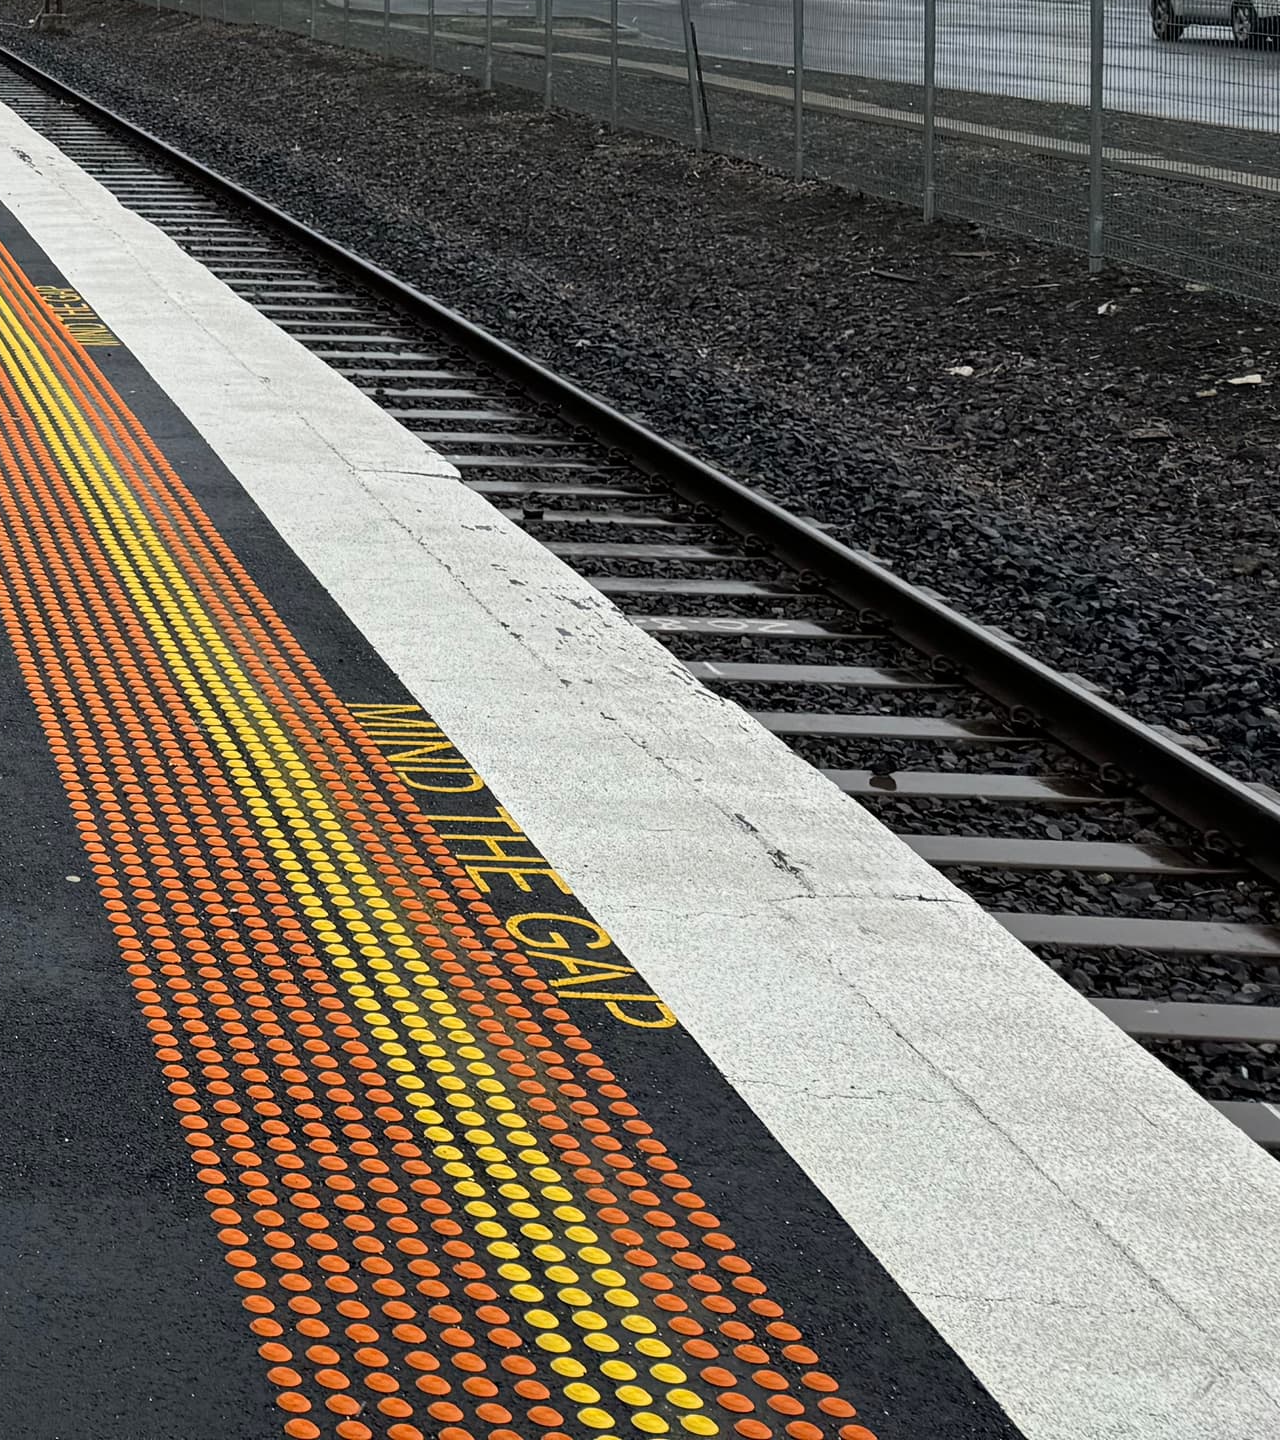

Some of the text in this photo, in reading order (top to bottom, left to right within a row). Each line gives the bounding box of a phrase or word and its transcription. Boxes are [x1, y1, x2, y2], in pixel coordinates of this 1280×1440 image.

[345, 702, 678, 1029] MIND THE GAP
